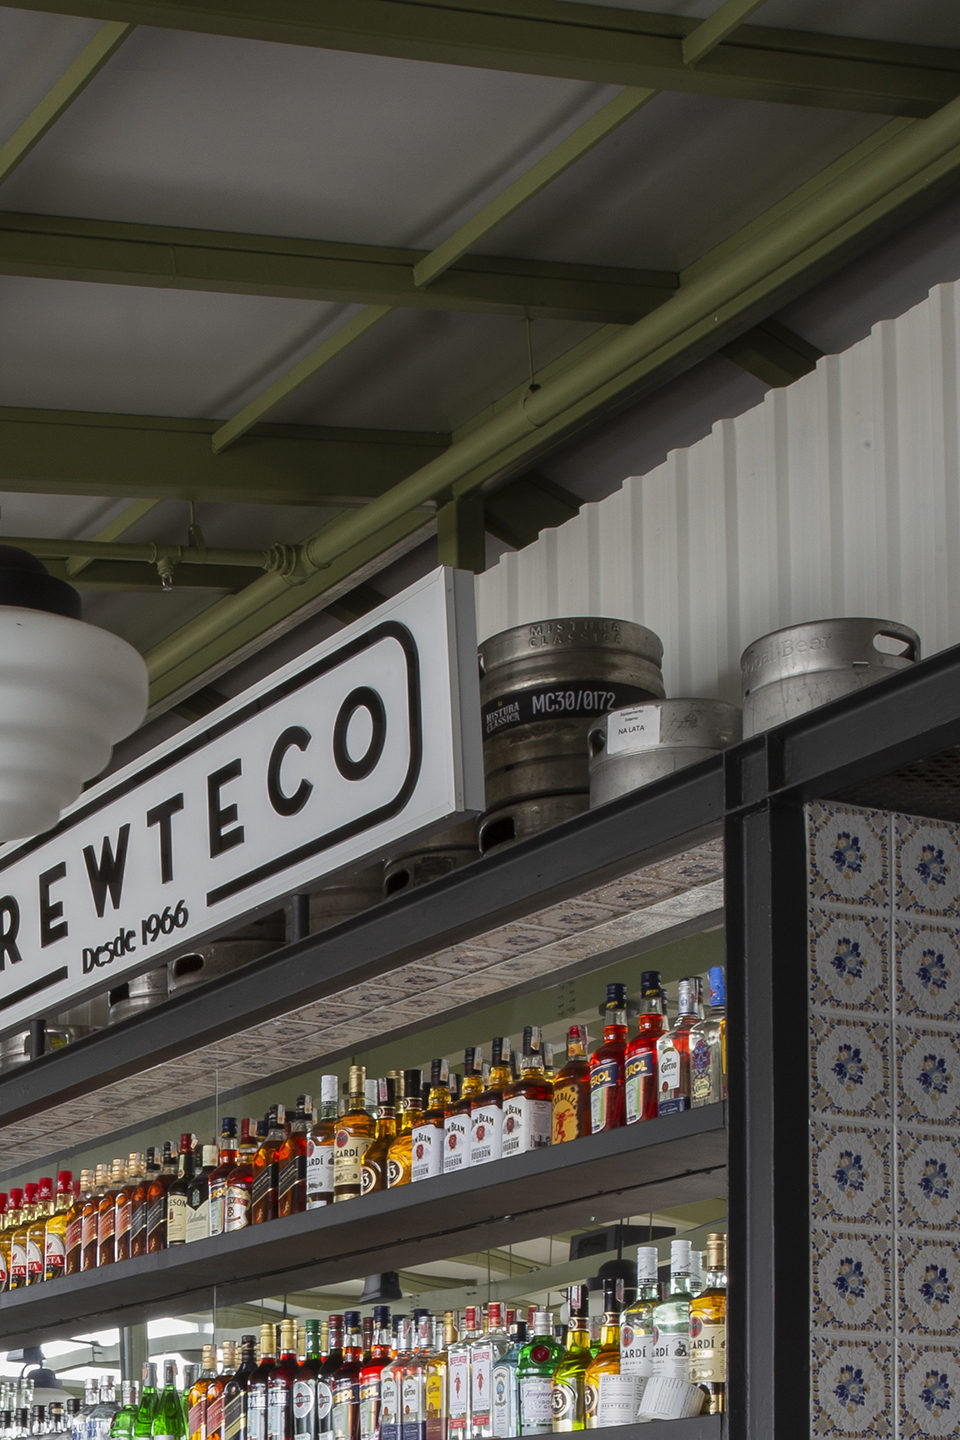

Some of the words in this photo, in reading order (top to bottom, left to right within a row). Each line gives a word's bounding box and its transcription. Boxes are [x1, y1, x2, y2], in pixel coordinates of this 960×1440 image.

[530, 621, 621, 637] MISTURA
[529, 633, 622, 648] CLASSICA
[532, 691, 616, 714] MC30/0172
[486, 701, 520, 724] MISTURA
[629, 725, 645, 733] LATA
[82, 927, 137, 975] Desde
[141, 898, 189, 946] 1966
[625, 1060, 648, 1079] EROL
[590, 1070, 612, 1088] EROL
[336, 1146, 359, 1158] CARDÍ
[169, 1199, 187, 1207] ESON
[689, 1336, 716, 1349] CARDÍ
[621, 1345, 647, 1359] CARDÍ
